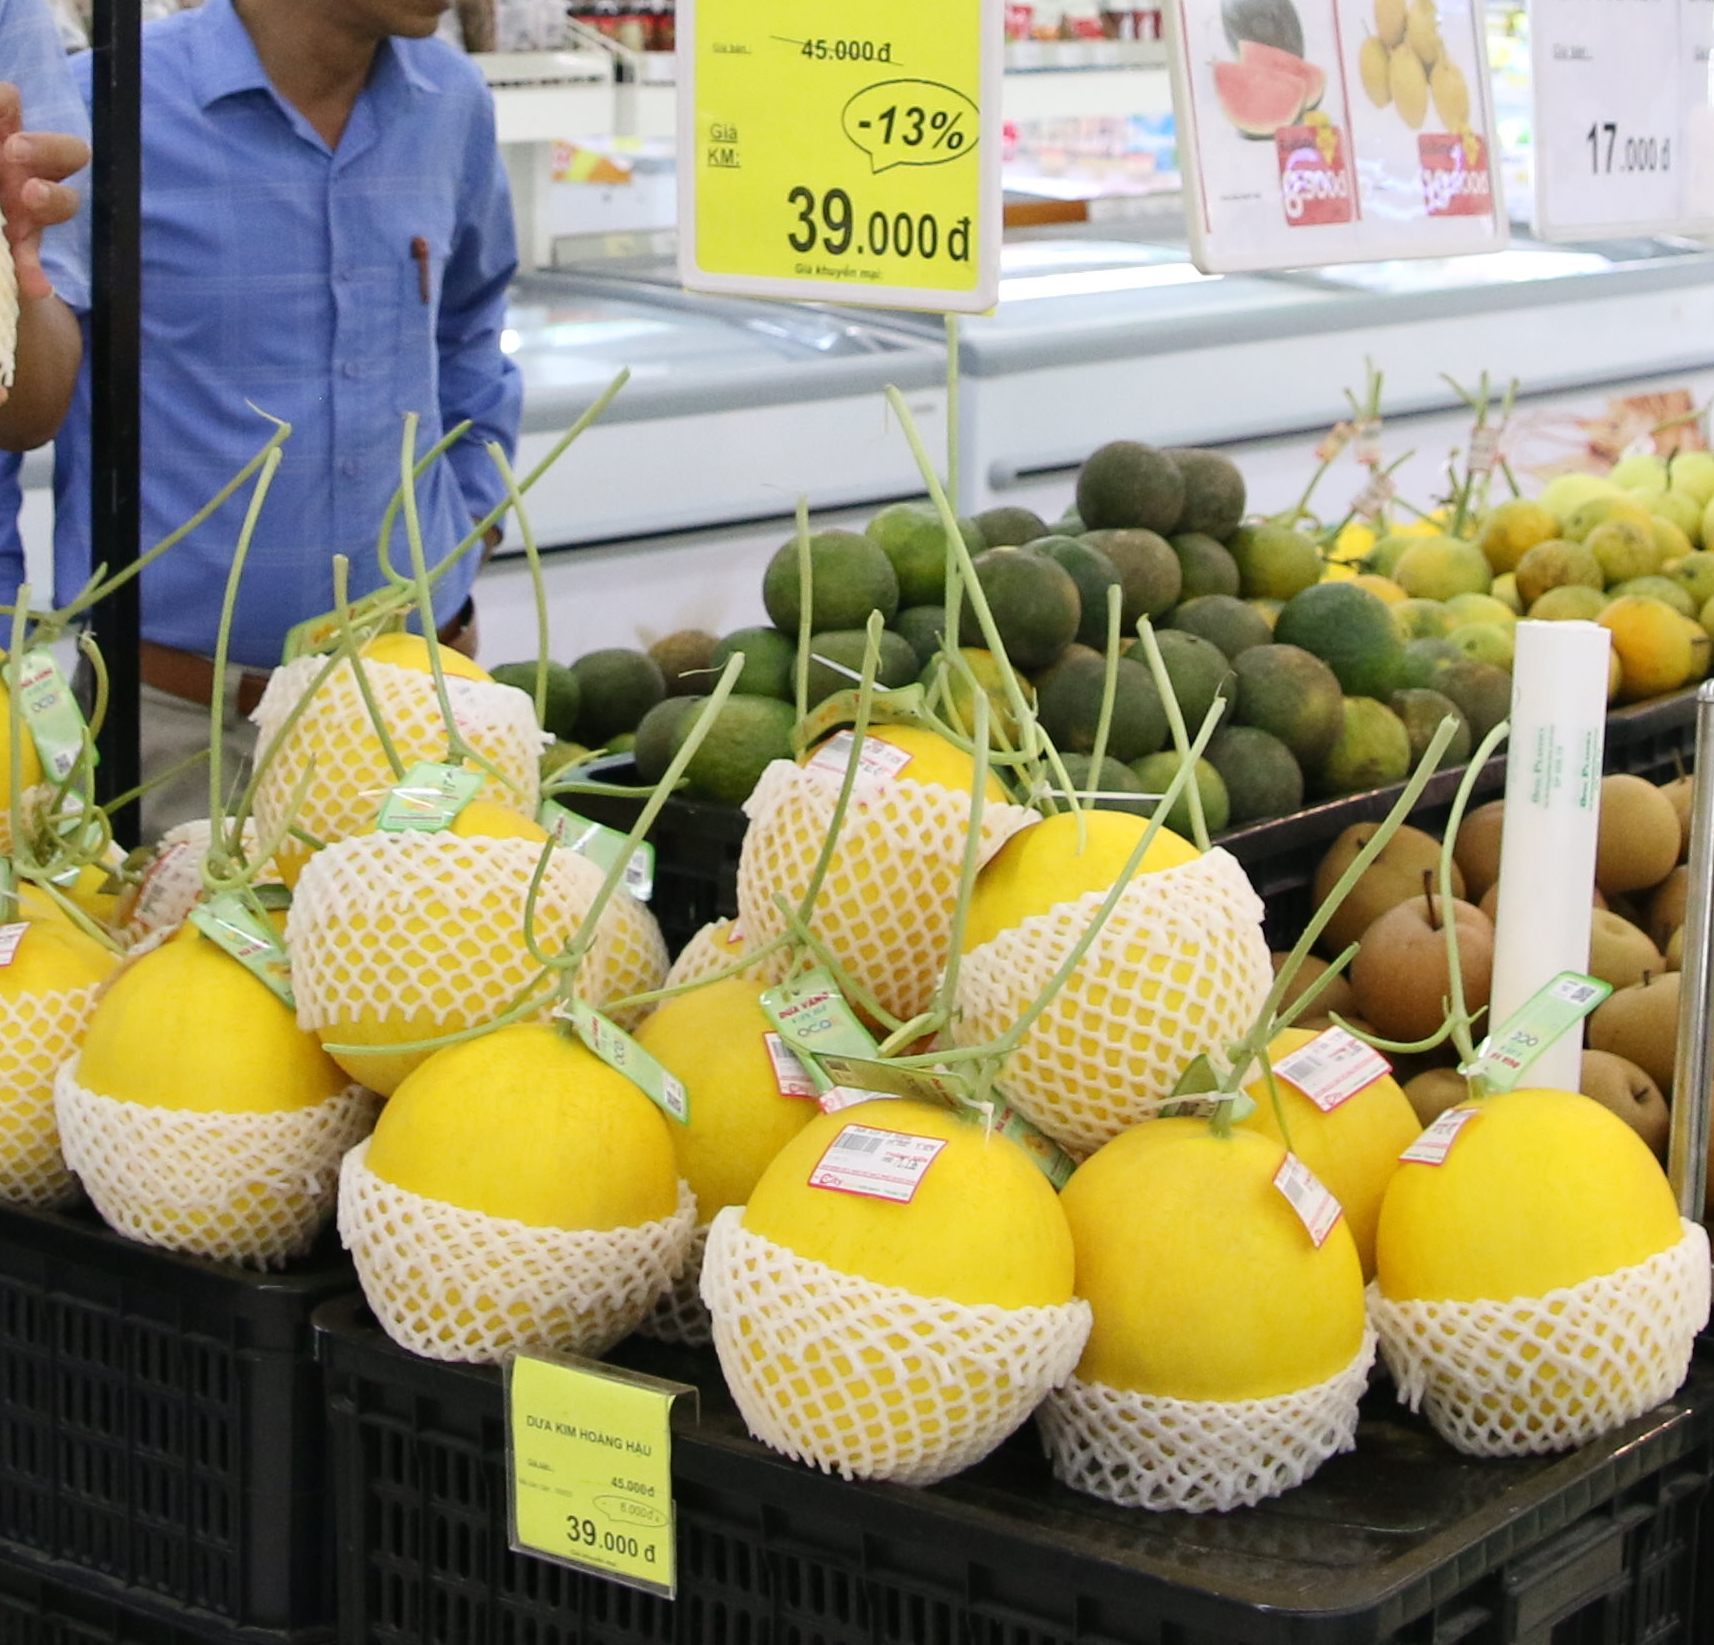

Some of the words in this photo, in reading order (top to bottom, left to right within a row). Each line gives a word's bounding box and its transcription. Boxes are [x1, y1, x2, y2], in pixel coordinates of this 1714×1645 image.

[709, 122, 739, 143] Giá
[857, 105, 965, 151] -13%
[707, 147, 741, 168] KM:
[786, 185, 939, 258] 39.000
[525, 1414, 553, 1434] DƯA
[555, 1419, 578, 1439] KIM
[565, 1514, 639, 1558] 39.000
